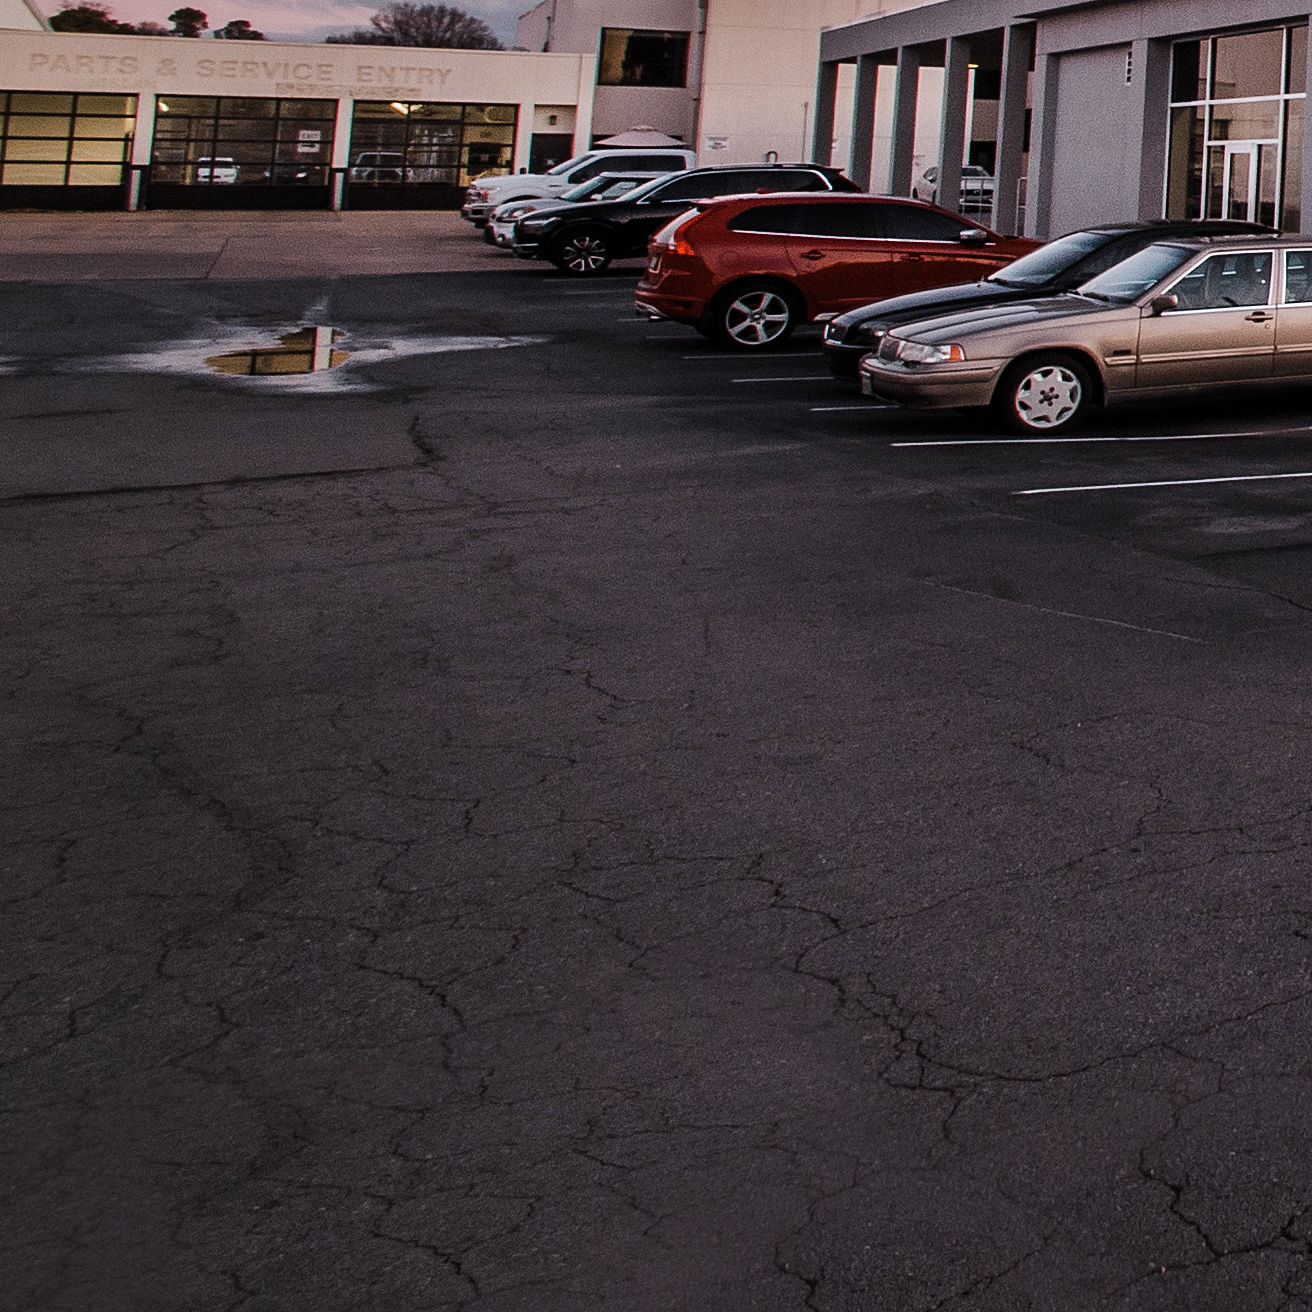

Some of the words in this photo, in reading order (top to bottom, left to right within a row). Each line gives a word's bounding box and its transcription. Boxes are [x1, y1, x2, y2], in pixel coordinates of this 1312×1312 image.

[29, 52, 139, 75] PARTS
[157, 57, 178, 77] &
[197, 58, 334, 82] SERVICE
[356, 64, 453, 85] ENTRY
